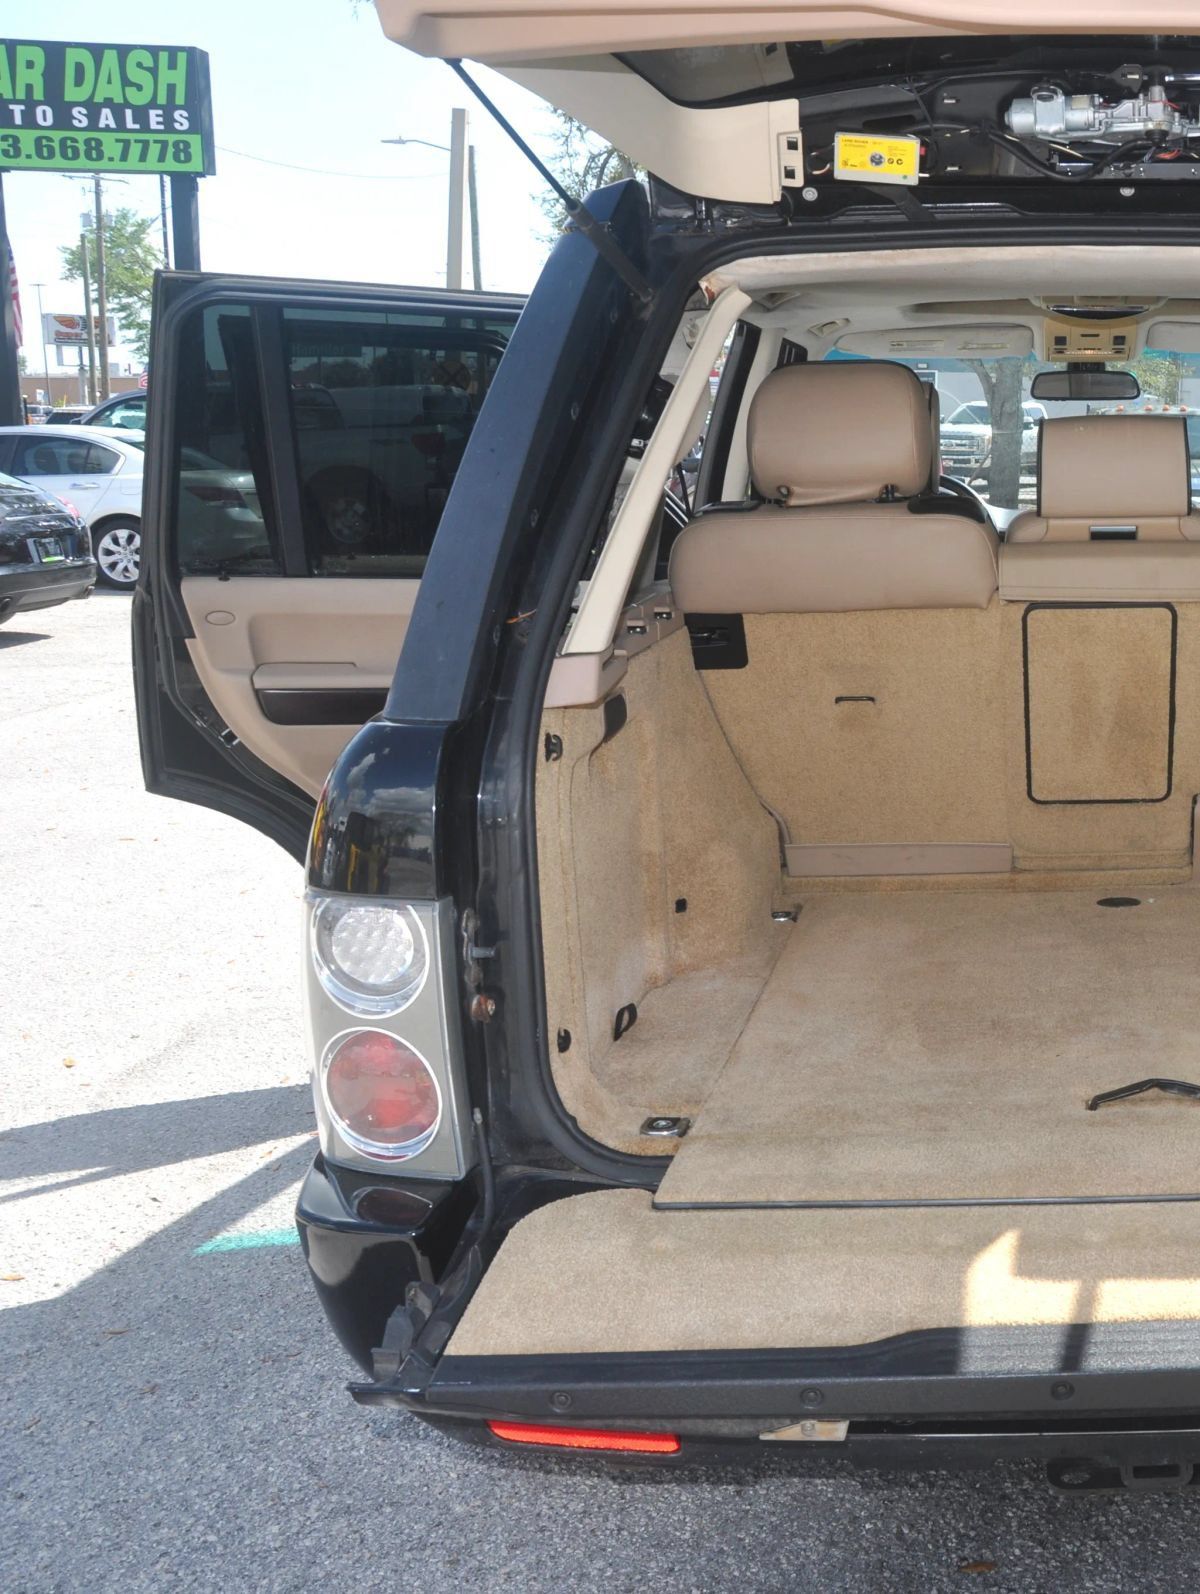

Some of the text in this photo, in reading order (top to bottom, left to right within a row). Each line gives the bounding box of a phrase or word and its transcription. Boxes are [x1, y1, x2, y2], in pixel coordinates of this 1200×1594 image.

[64, 47, 187, 106] DASH
[71, 106, 190, 131] SALES
[0, 134, 193, 164] 3.668.7778
